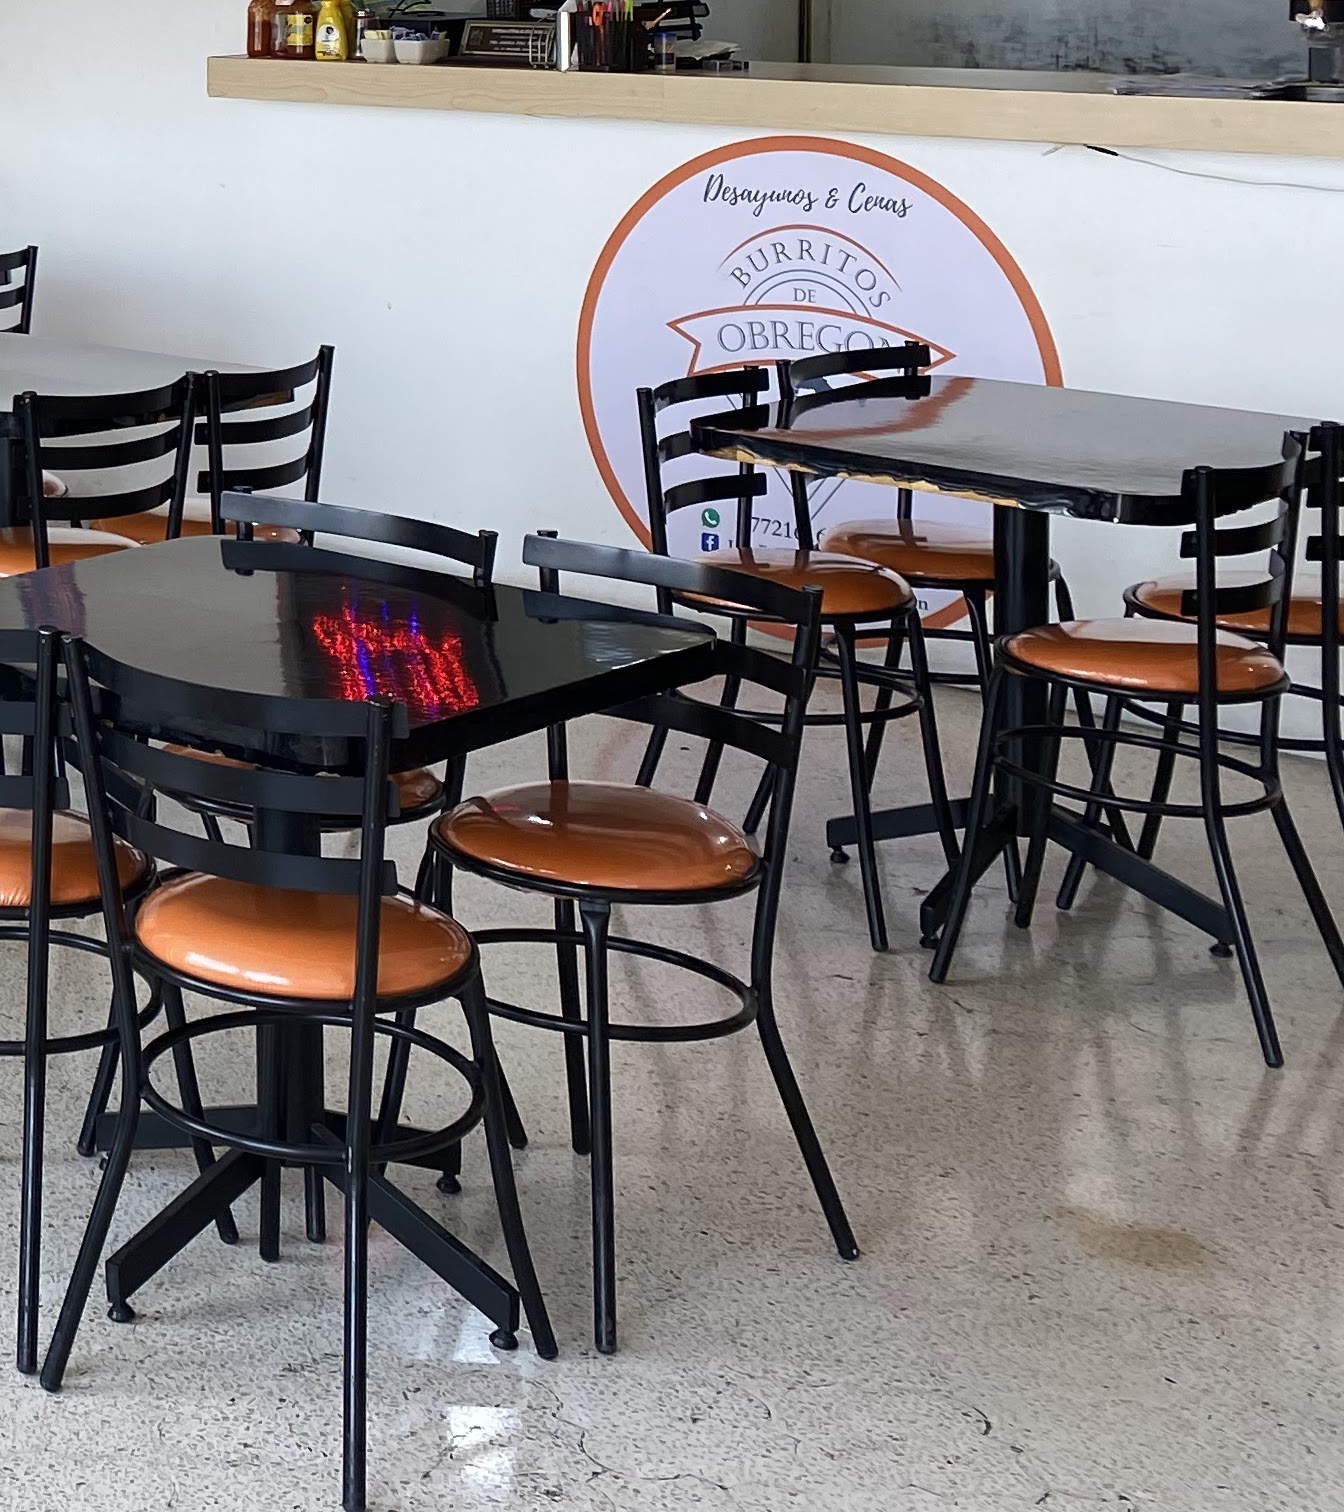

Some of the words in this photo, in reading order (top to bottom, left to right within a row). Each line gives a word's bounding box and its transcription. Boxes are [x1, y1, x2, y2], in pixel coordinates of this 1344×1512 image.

[703, 172, 820, 218] Desayunos
[825, 187, 840, 209] &
[848, 182, 914, 219] Cenas
[728, 238, 892, 309] BURRITOS
[793, 287, 817, 303] DE
